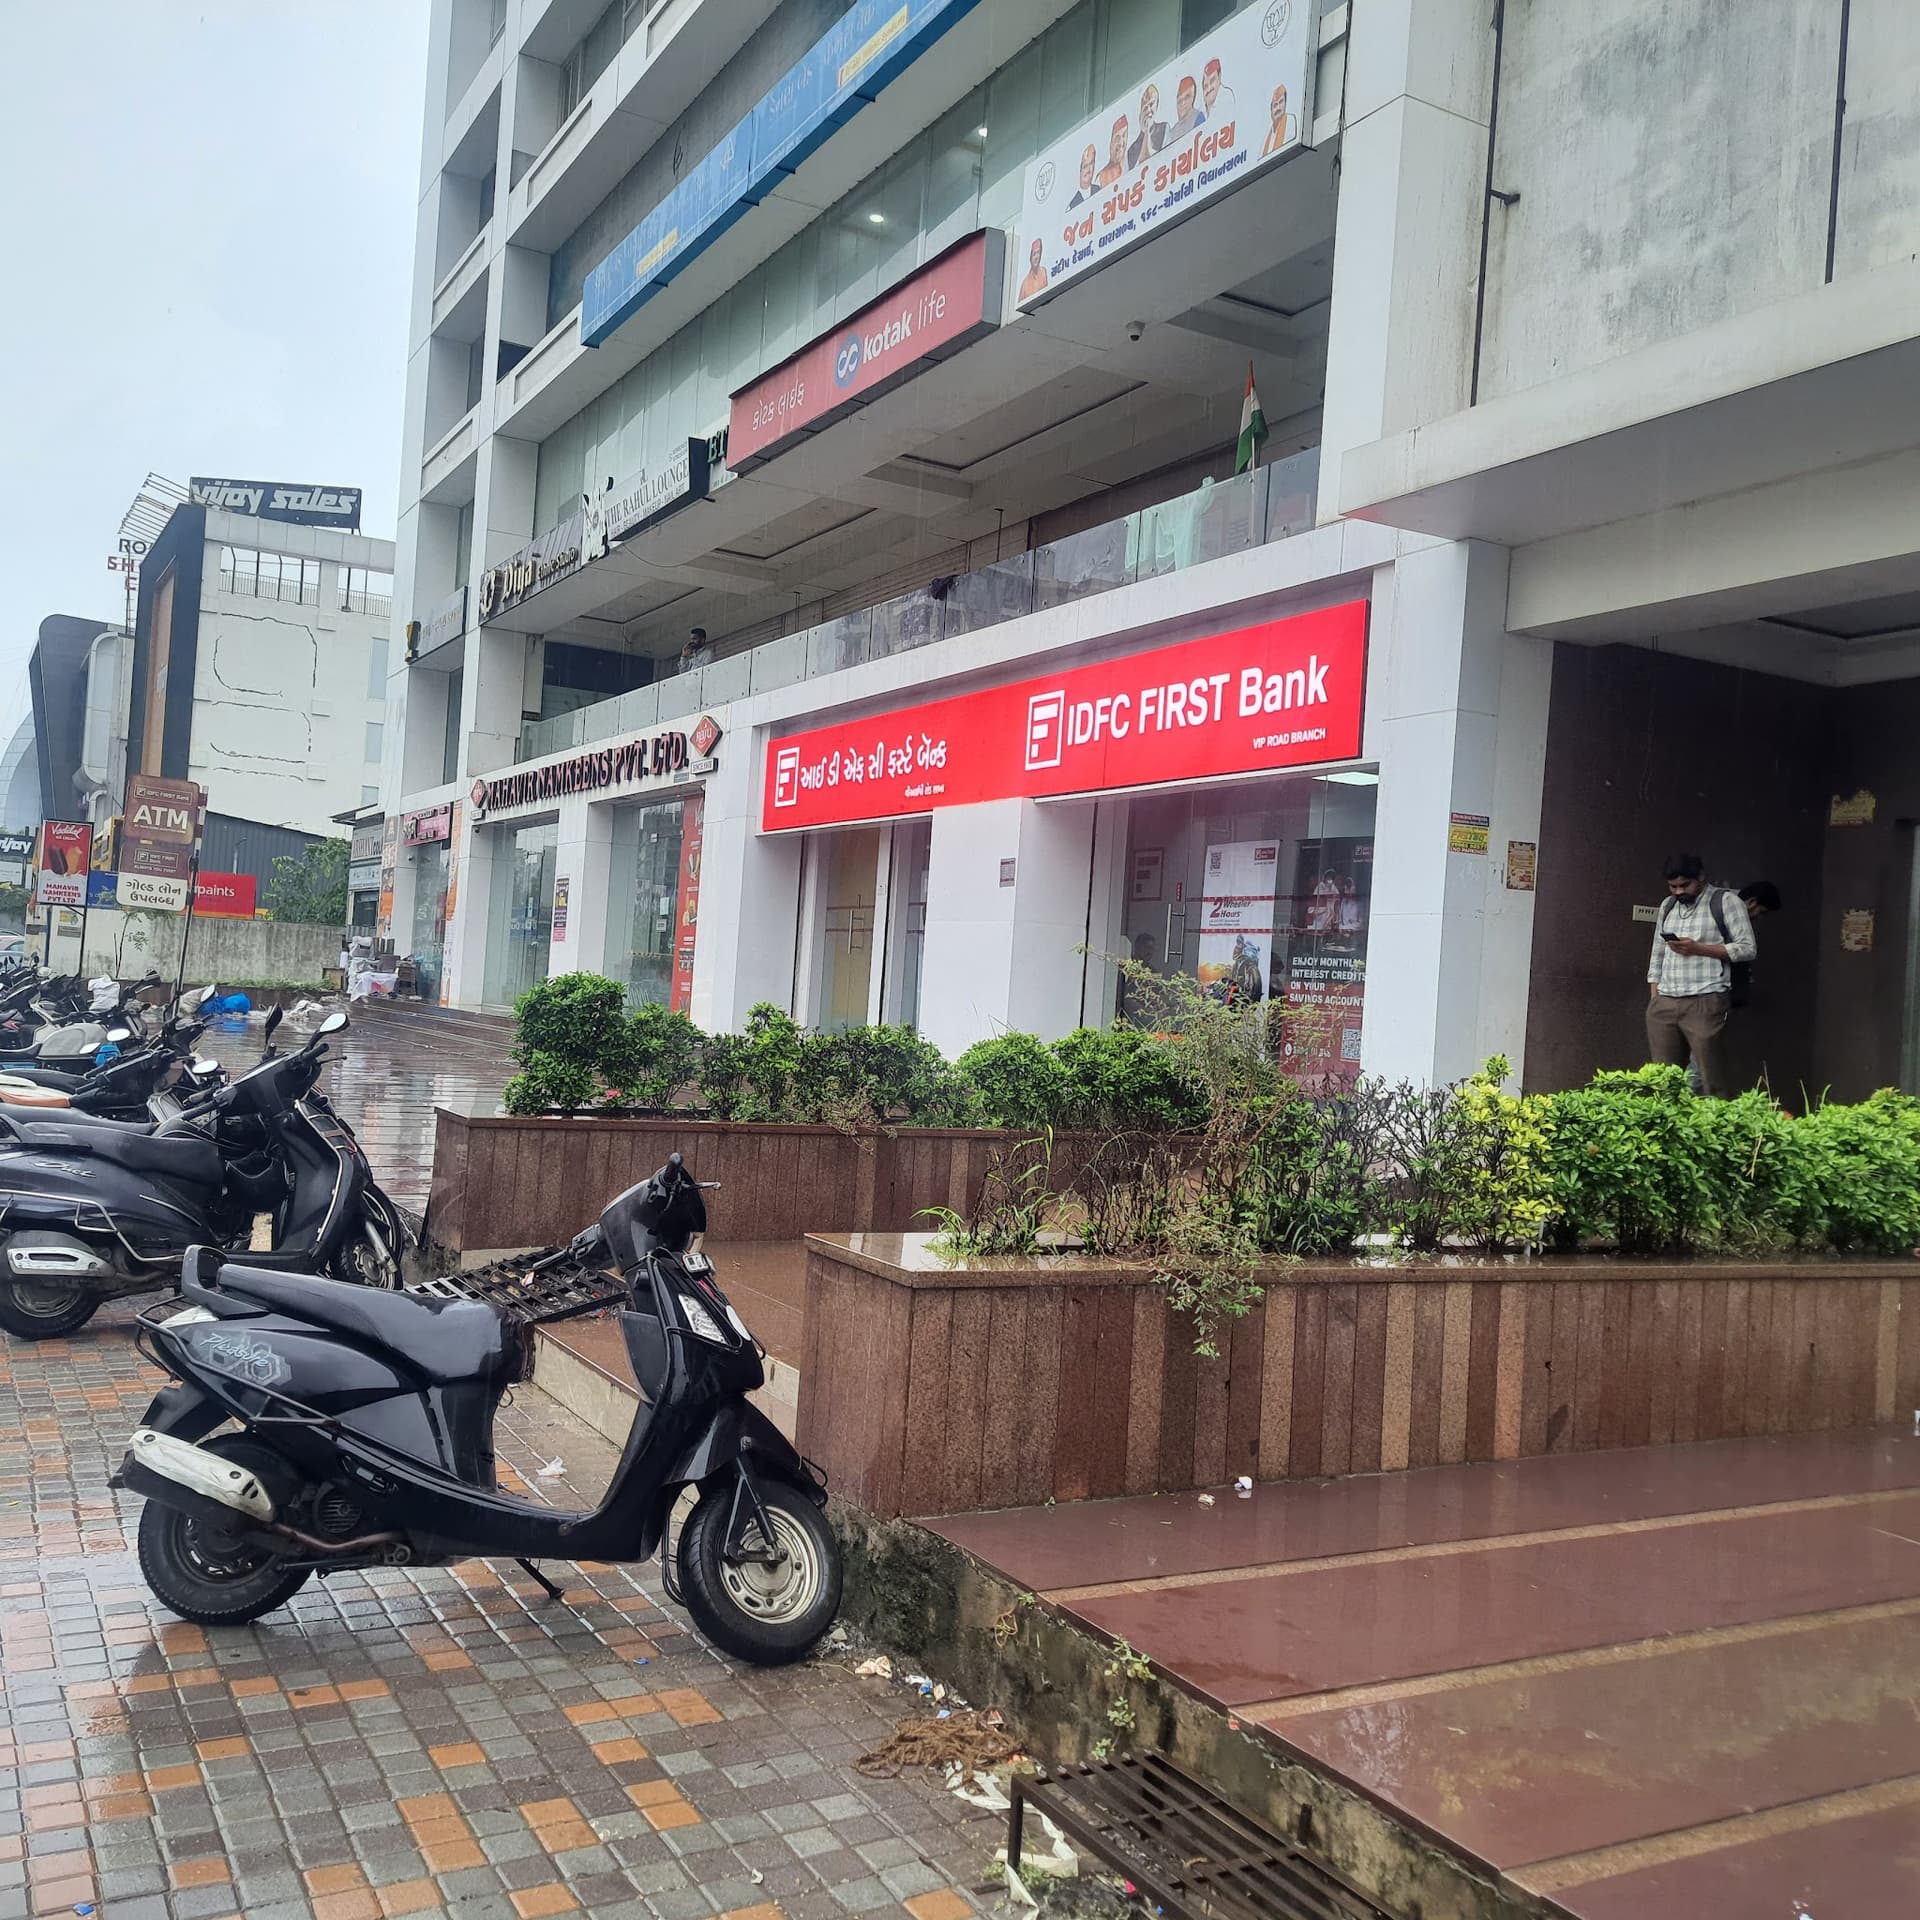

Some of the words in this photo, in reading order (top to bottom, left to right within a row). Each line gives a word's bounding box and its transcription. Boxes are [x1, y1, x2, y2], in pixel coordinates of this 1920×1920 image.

[1063, 211, 1094, 247] જન
[1101, 165, 1149, 226] સંપર્ક
[1154, 120, 1236, 192] કાર્યાલય
[863, 311, 912, 364] kotak
[917, 289, 946, 331] life
[752, 398, 775, 432] કોટક
[191, 481, 264, 514] vijay
[269, 487, 358, 515] sales
[604, 503, 622, 528] THE
[622, 481, 651, 517] RAHUL
[651, 458, 689, 499] LOUNGE
[1067, 694, 1131, 746] IDFC
[1138, 672, 1231, 735] FIRST
[1239, 655, 1331, 718] Bank
[1253, 736, 1266, 750] VIP
[1267, 733, 1290, 747] ROAD
[1290, 728, 1327, 744] BRANCH
[487, 770, 538, 812] MAHAVIR
[538, 751, 613, 800] NAMKEENS
[649, 732, 690, 776] LTD.
[800, 756, 827, 790] આઈ
[827, 750, 841, 787] ડી
[844, 747, 864, 784] એફ
[868, 741, 884, 780] સી
[887, 735, 913, 779] ફર્સ્ટ
[133, 804, 188, 829] ATM
[43, 889, 81, 898] NAMKEENS
[46, 883, 79, 891] MAHAVIR
[126, 878, 154, 892] ગોલ્ડ
[158, 882, 181, 895] લોન
[130, 891, 175, 906] ઉપલબ્ધ
[1209, 896, 1224, 918] 2
[1220, 908, 1241, 918] Hours
[1292, 957, 1318, 966] ENJOY
[1319, 957, 1361, 969] MONTHL
[1291, 981, 1301, 990] ON
[1304, 982, 1326, 992] YOUR
[1289, 994, 1323, 1004] SAVINGS
[200, 1332, 270, 1368] Pleasure
